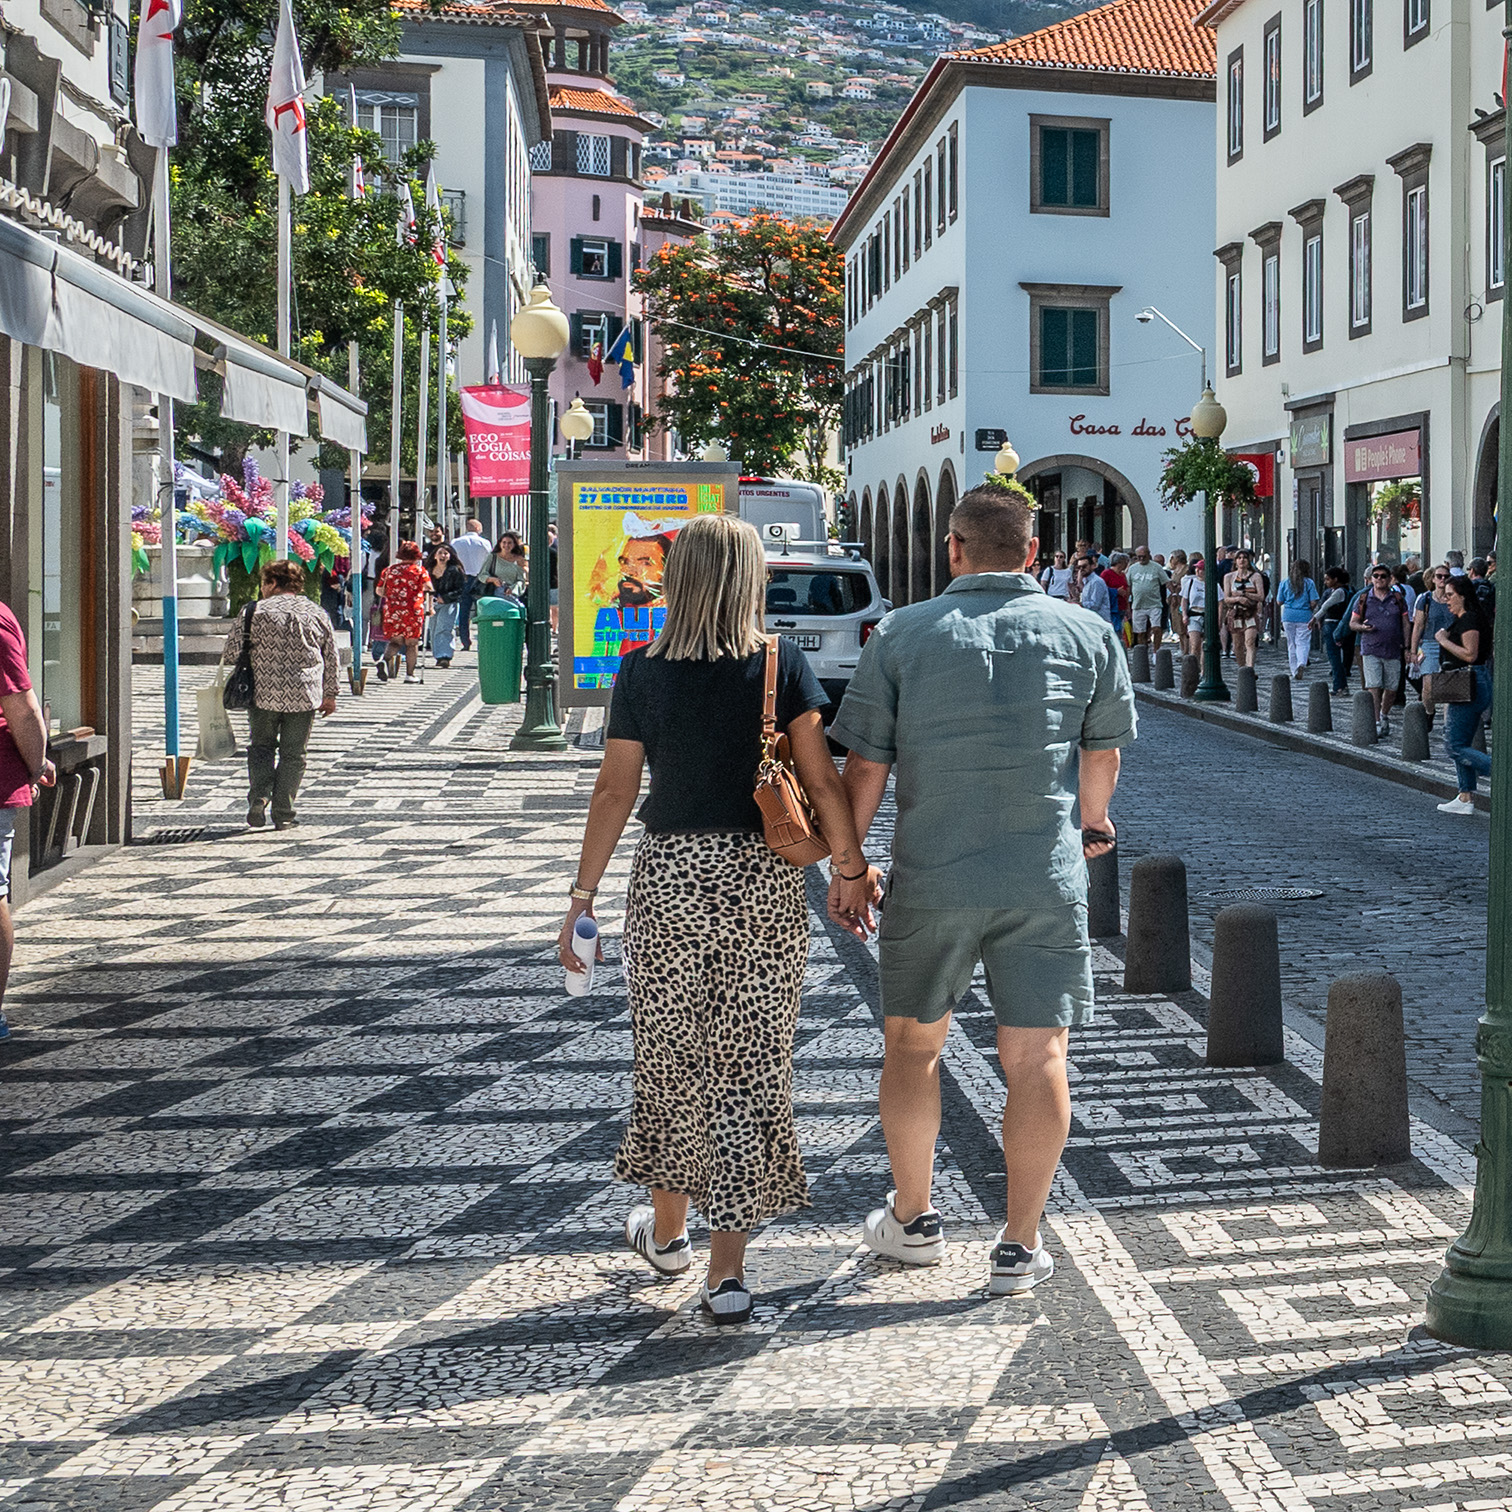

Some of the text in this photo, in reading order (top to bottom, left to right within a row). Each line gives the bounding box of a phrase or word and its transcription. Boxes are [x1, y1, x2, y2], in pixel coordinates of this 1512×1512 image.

[1069, 414, 1121, 435] Casa
[1131, 418, 1166, 436] das
[469, 433, 498, 443] ECO
[471, 442, 512, 453] LOGIA
[489, 450, 531, 461] COISAS
[1368, 443, 1406, 473] People's Phone
[579, 494, 688, 504] 27 SETEMBRO
[774, 619, 797, 628] Jeep
[594, 631, 650, 642] SUPER
